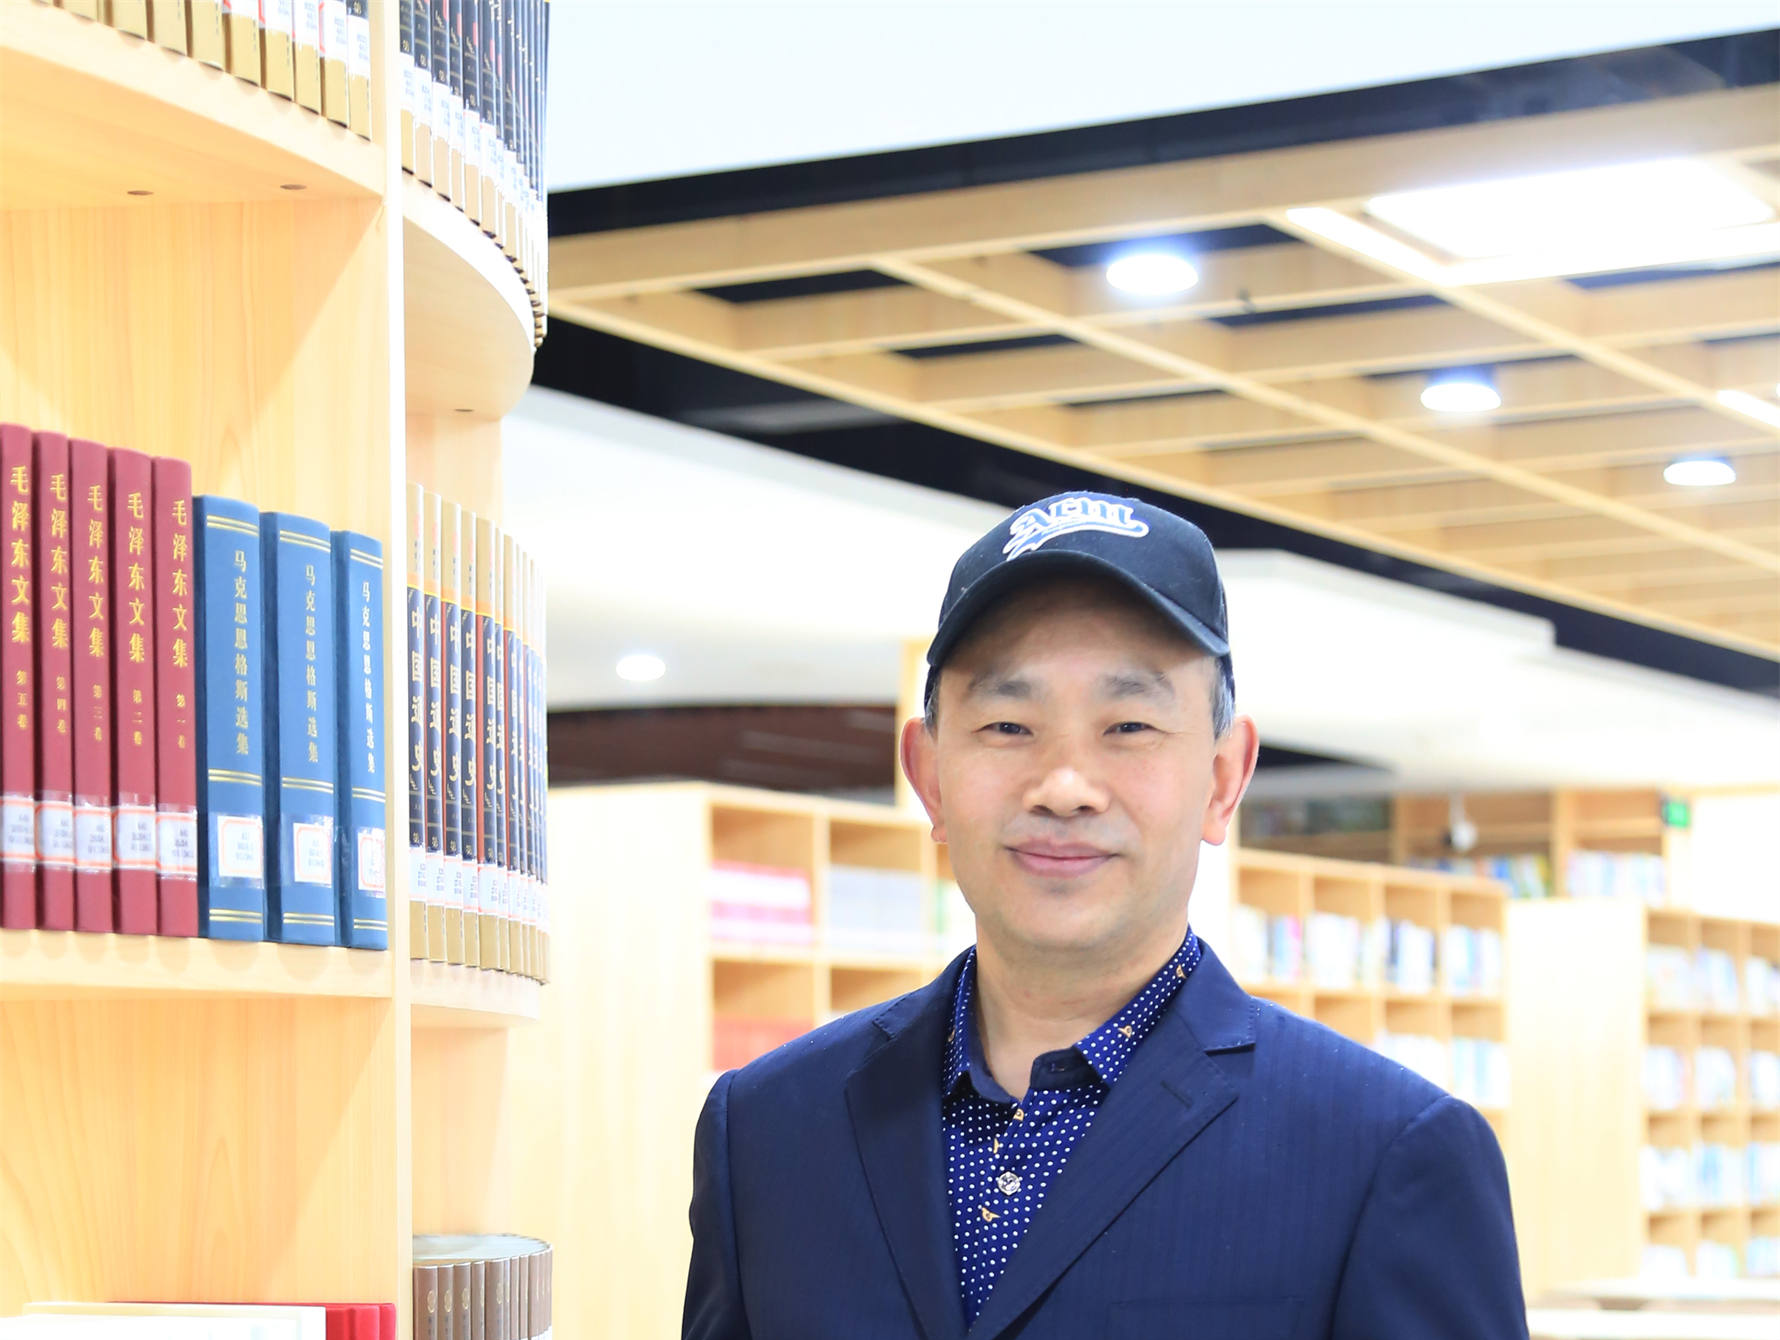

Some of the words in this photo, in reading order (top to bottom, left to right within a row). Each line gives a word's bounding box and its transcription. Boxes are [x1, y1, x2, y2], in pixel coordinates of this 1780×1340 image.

[10, 465, 30, 644] 毛泽东文集
[49, 473, 68, 649] 毛泽东文集
[88, 485, 104, 657] 毛泽东文集
[127, 492, 145, 664] 毛泽东文集
[172, 500, 188, 668] 毛泽东文集
[234, 550, 249, 755] 马克思恩格斯选集
[305, 565, 319, 763] 马克思恩格斯选集
[361, 581, 375, 774] 马克思恩格斯选集
